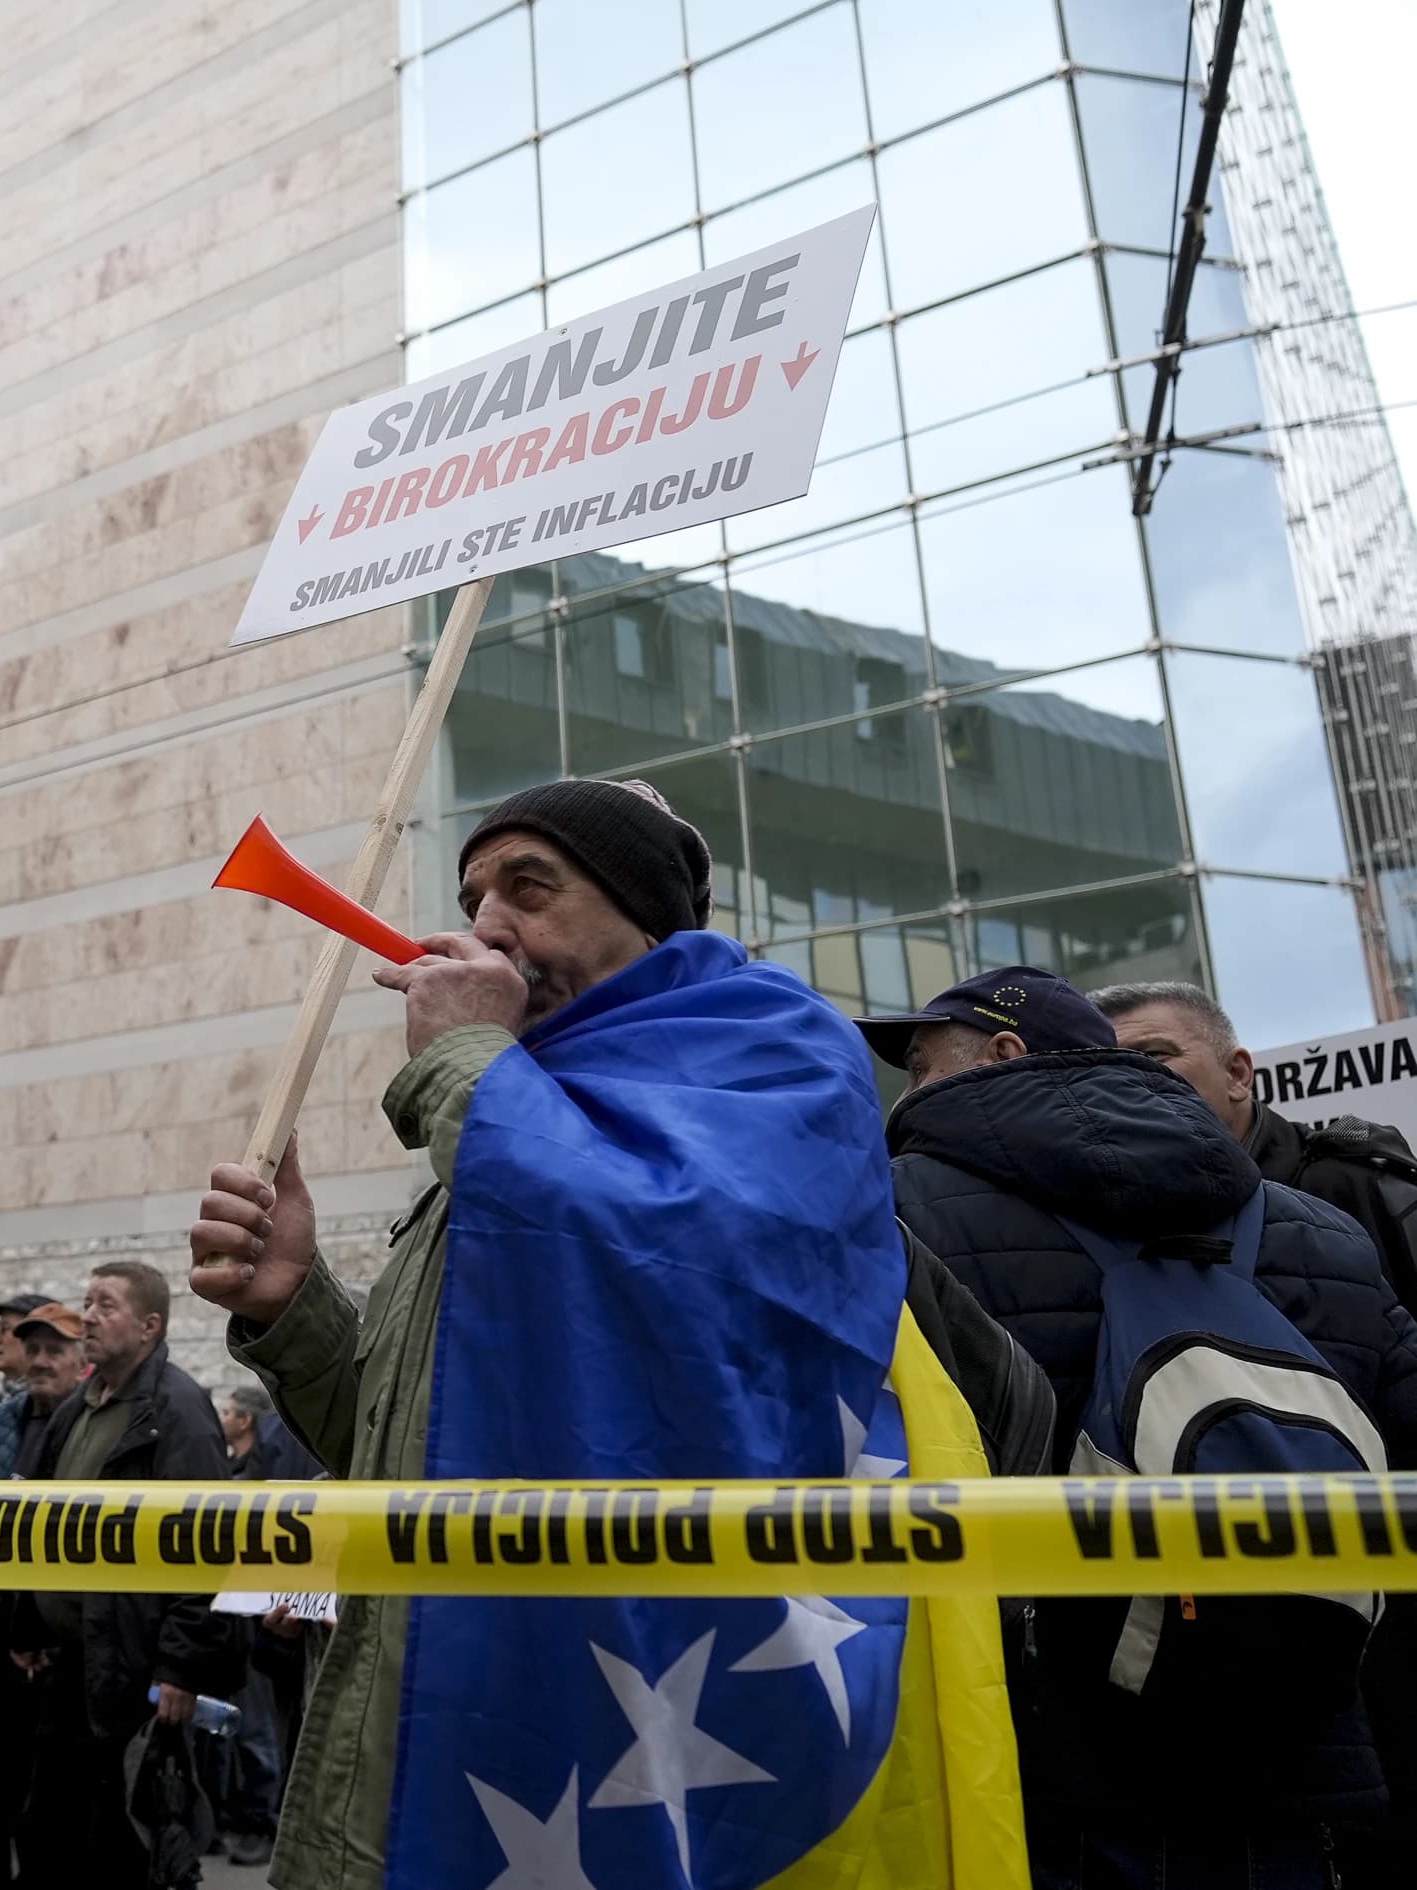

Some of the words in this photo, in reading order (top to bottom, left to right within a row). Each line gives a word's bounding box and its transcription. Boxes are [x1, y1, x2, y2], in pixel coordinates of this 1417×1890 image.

[354, 252, 801, 470] SMANJITE
[329, 353, 763, 541] BIROKRACIJU
[289, 538, 452, 612] SMANJILI
[457, 516, 525, 565] STE
[531, 451, 754, 543] INFLACIJU
[1252, 1036, 1417, 1105] DRŽAVA
[158, 1493, 318, 1566] STOP
[385, 1488, 715, 1566] POLICIJA
[745, 1485, 966, 1565] STOP
